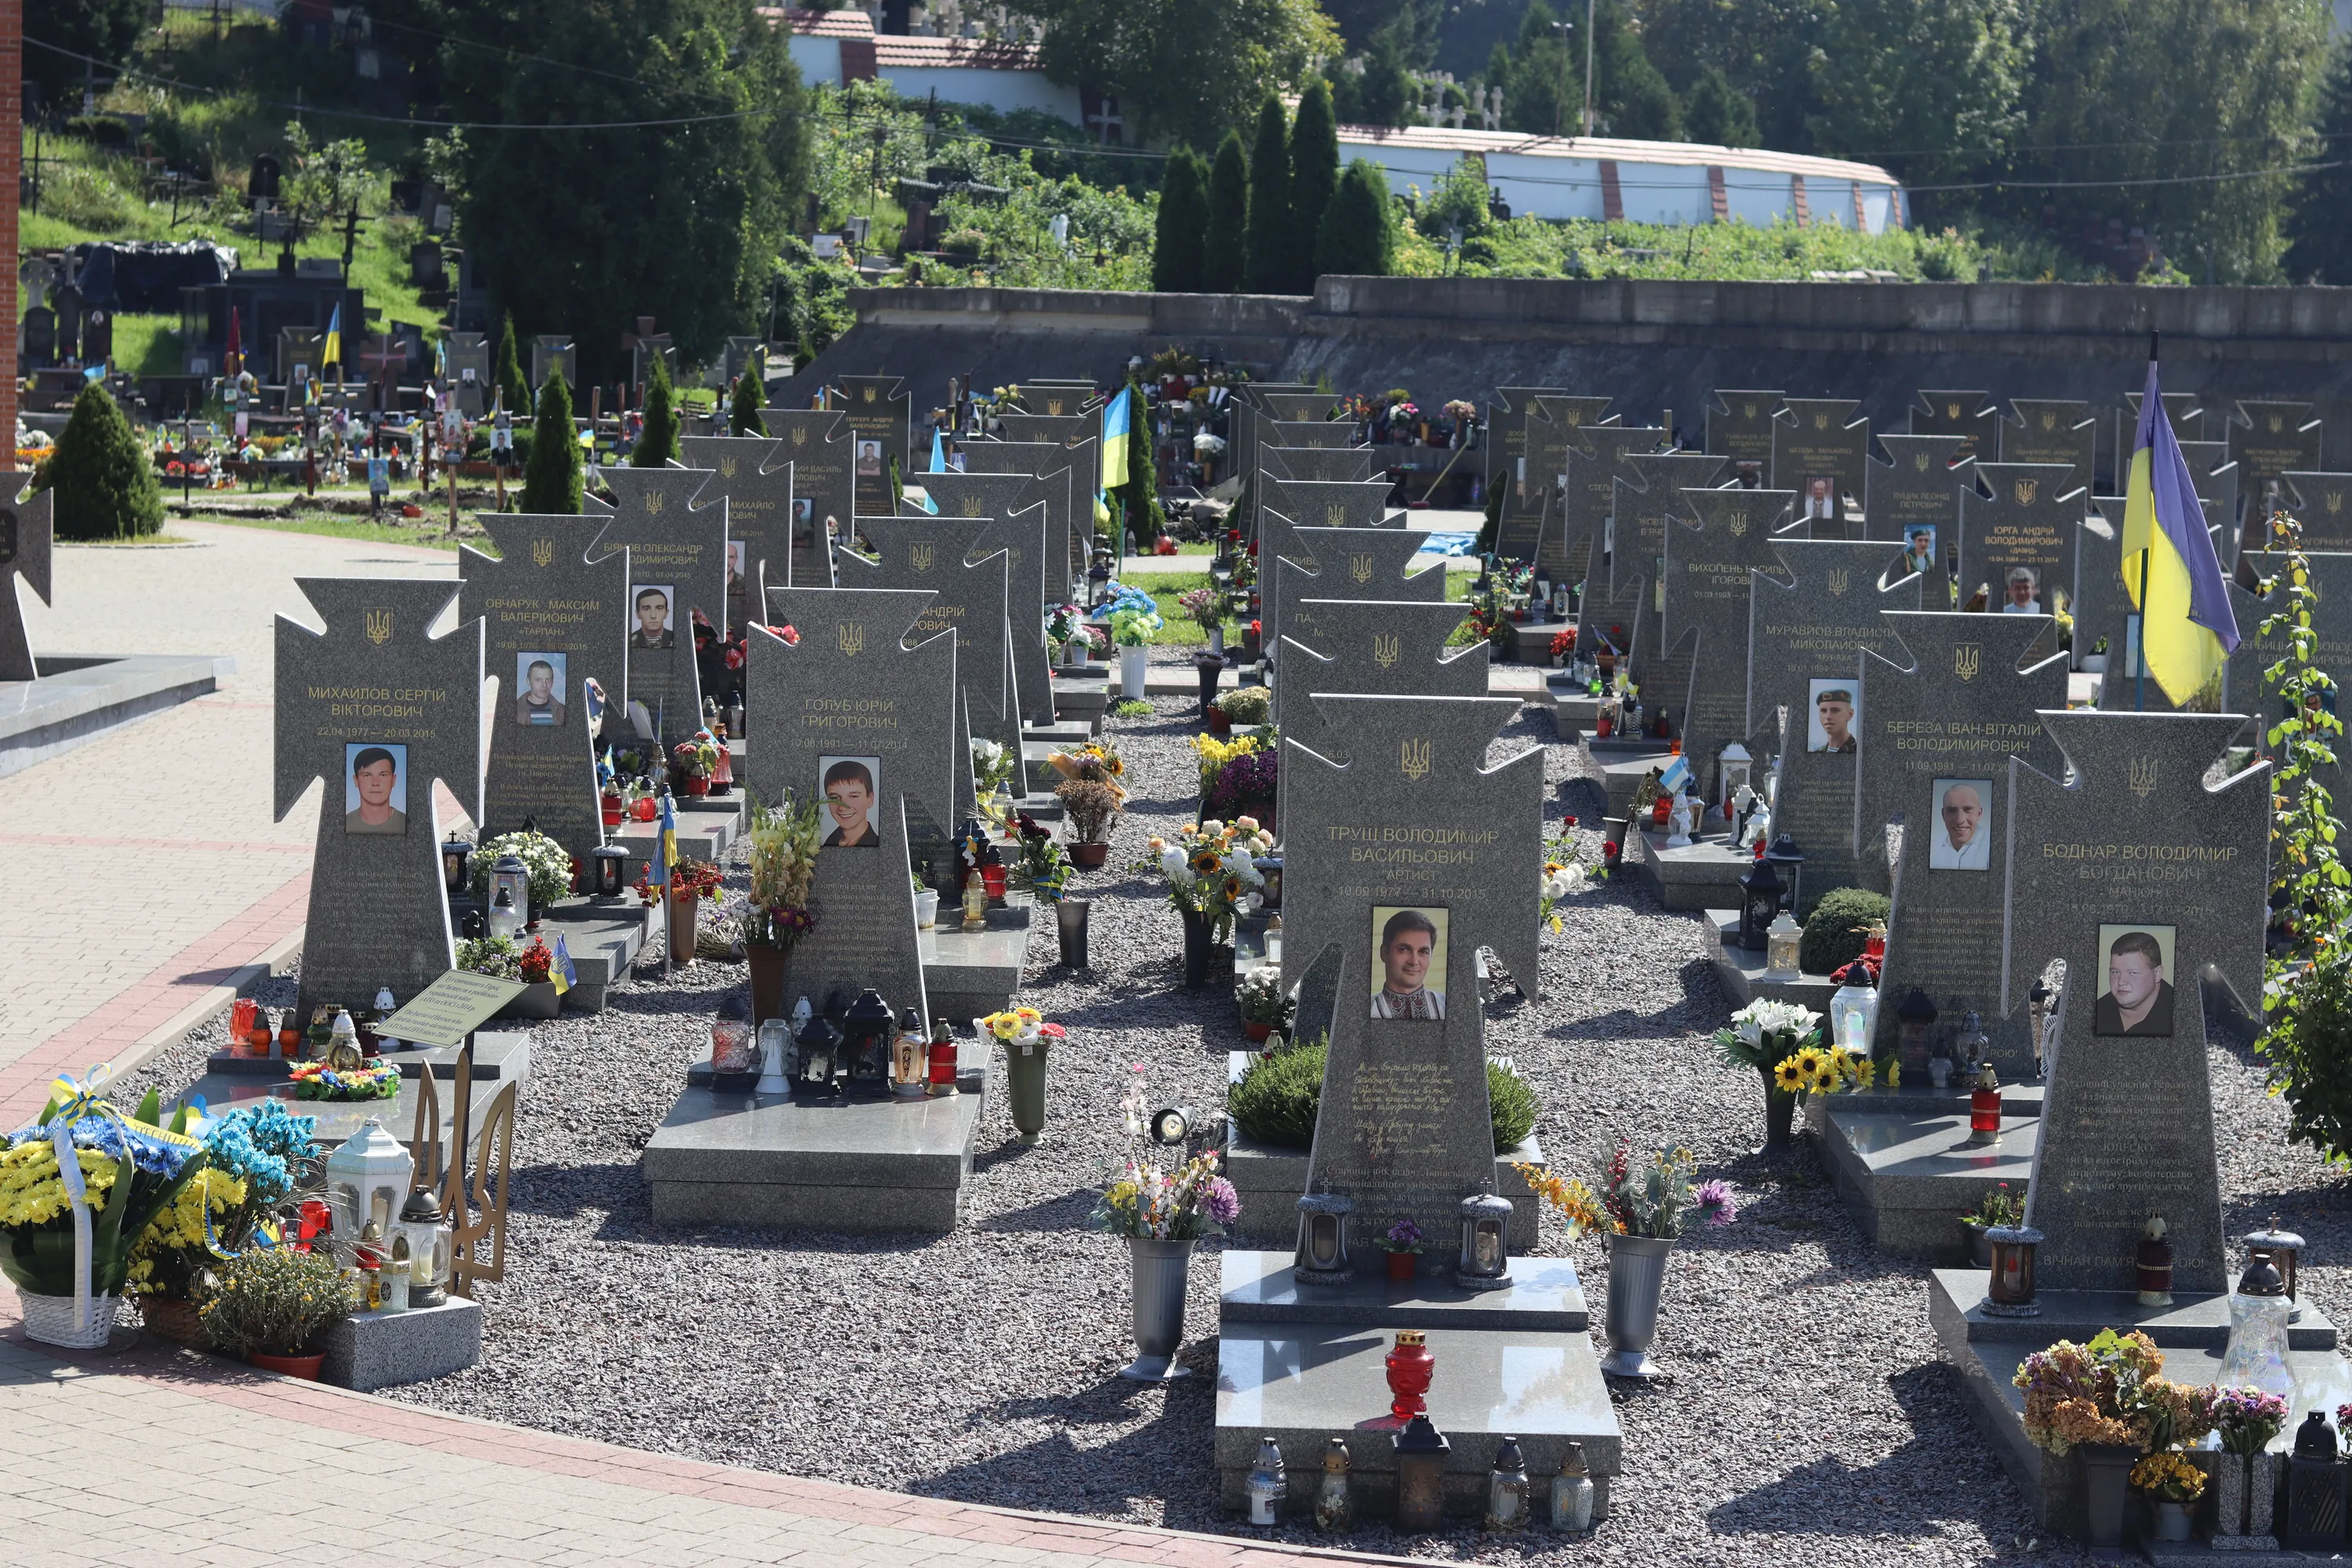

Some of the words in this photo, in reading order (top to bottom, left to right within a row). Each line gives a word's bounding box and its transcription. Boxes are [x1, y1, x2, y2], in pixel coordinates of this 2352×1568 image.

[1921, 492, 1950, 502] ЛЕОНІД
[731, 499, 775, 510] МИХАЙЛО
[1994, 525, 2019, 535] ЮРГА
[2023, 525, 2055, 536] АНДРІЙ
[1985, 535, 2063, 546] ВОЛОДИМИРОВИЧ
[643, 543, 703, 554] ОЛЕКСАНДР
[629, 555, 698, 565] ОДИМИРОВИЧ
[1689, 564, 1743, 573] ВИХОПЕНЬ
[485, 598, 539, 609] ОВЧАРУК
[549, 600, 600, 611] МАКСИМ
[921, 604, 966, 618] АНДРІЙ
[500, 611, 584, 623] ВАЛЕРІЙОВИЧ
[1835, 626, 1896, 638] ВЛАДИСЛА
[308, 685, 390, 702] МИХАЙЛОВ
[394, 687, 446, 702] СЕРГІЙ
[331, 703, 423, 718] ВІКТОРОВИЧ
[804, 698, 851, 713] ГОЛУБ
[855, 698, 894, 713] ЮРІЙ
[800, 715, 898, 730] ГРИГОРОВИЧ
[1887, 721, 1944, 735] БЕРЕЗА
[1947, 722, 2042, 736] ІВАН-ВІТАЛІЙ
[317, 727, 369, 738] 22.04.1977
[384, 728, 436, 739] 20.03.2015
[1897, 739, 2031, 753] ВОЛОДИМИРОВИЧ
[1904, 760, 1955, 771] 11.09.1991
[1972, 762, 2010, 772] 11.07.20
[1327, 826, 1377, 844] ТРУШ
[1382, 826, 1500, 845] ВОЛОДИМИР
[1351, 847, 1475, 865] ВАСИЛЬОВИЧ
[2043, 843, 2117, 859] БОДНАР
[2122, 844, 2238, 861] ВОЛОДИМИР
[2079, 864, 2201, 882] БОГДАНОВИЧ
[1338, 884, 1402, 898] 10.09.1977
[1421, 887, 1487, 900] 31.10.2015
[2043, 1254, 2091, 1267] ВІЧНАЯ
